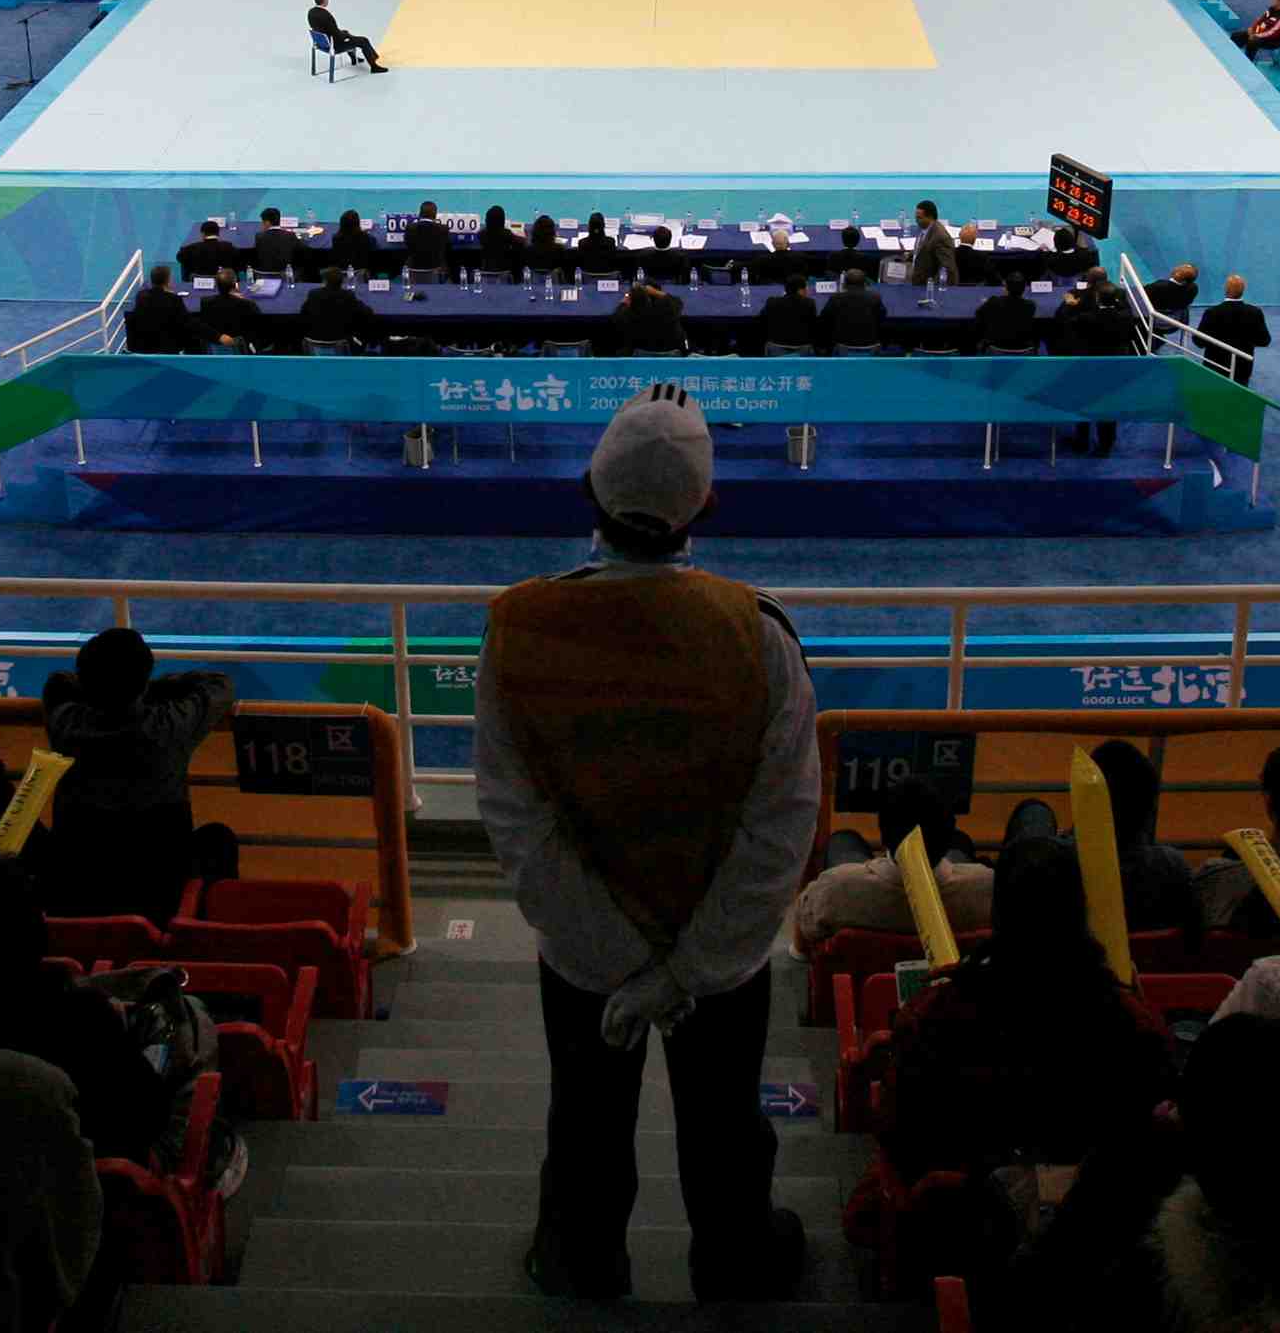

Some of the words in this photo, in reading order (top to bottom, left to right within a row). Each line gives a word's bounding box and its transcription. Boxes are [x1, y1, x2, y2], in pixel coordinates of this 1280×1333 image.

[429, 373, 573, 412] 好运北京
[735, 397, 778, 412] Open
[1070, 666, 1247, 707] 好运北京
[1082, 696, 1115, 705] GOOD
[1116, 696, 1146, 705] LUCK
[327, 725, 360, 754] 区
[933, 740, 961, 767] 区
[242, 739, 312, 776] 118
[842, 755, 912, 793] 119
